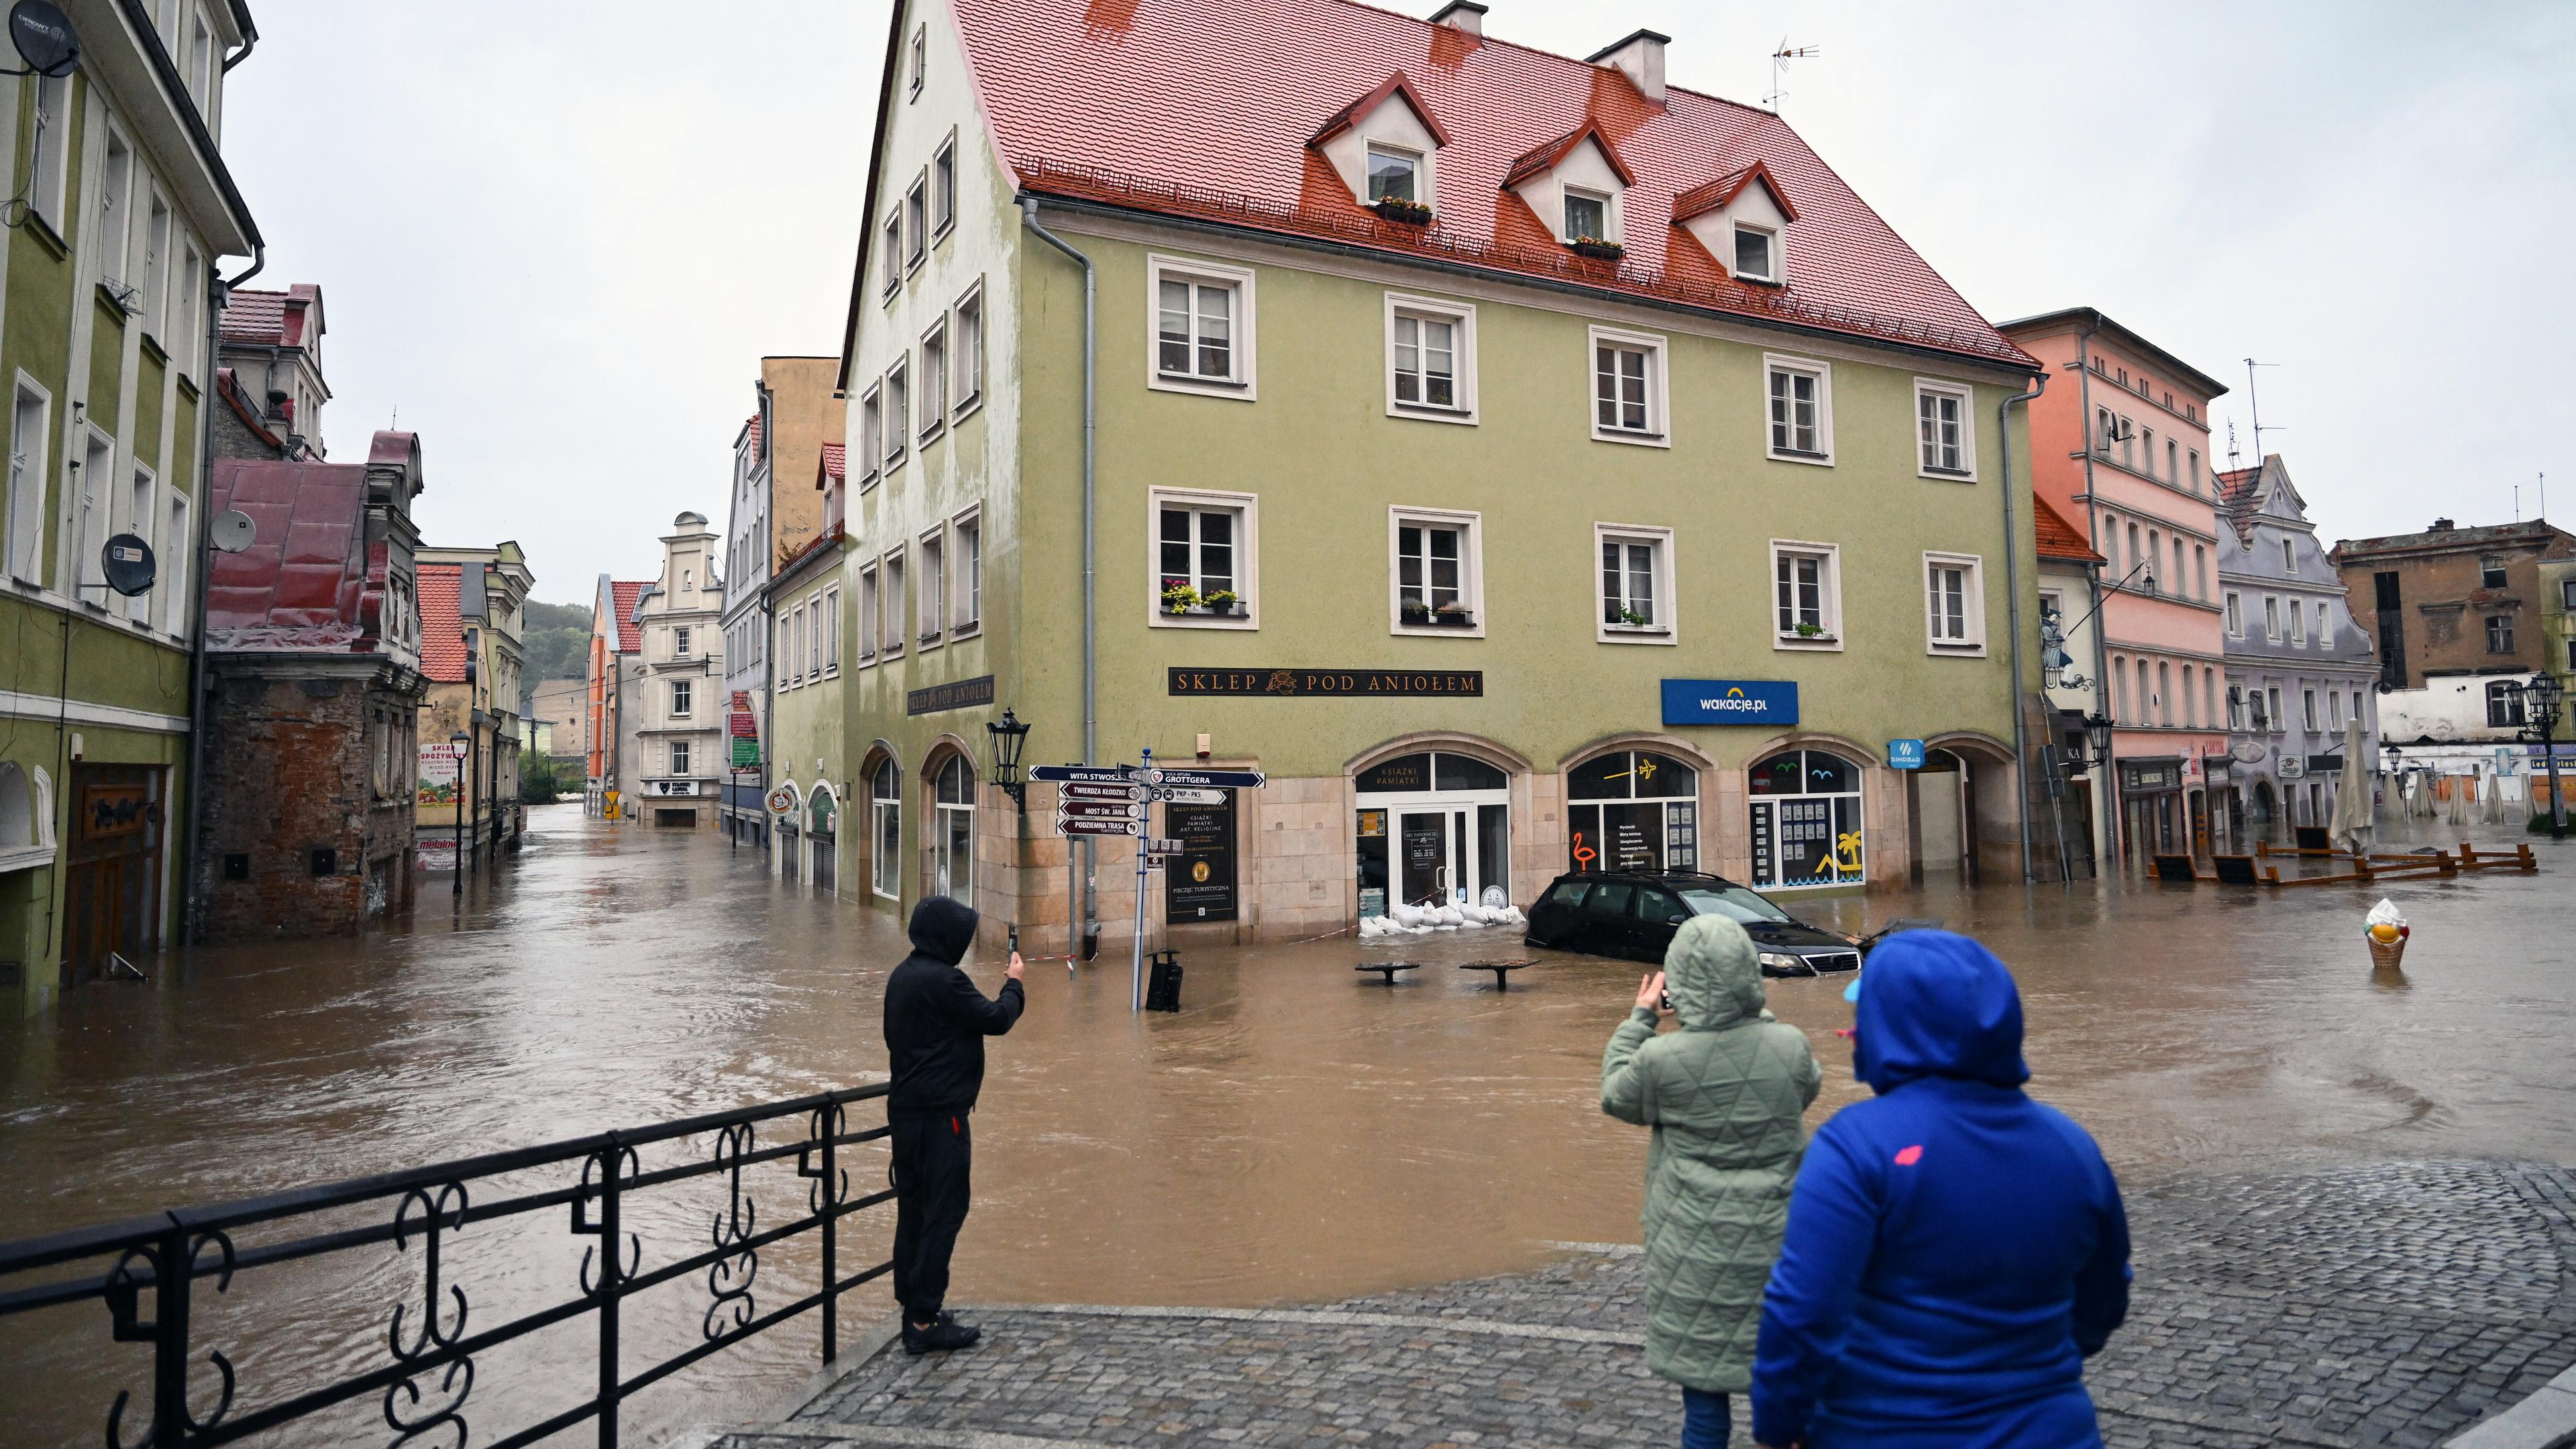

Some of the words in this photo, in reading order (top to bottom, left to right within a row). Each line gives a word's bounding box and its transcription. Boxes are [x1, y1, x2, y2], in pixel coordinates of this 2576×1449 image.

[18, 14, 49, 31] CYFROWY
[1178, 674, 1256, 690] SKLEP
[1306, 675, 1354, 690] POD
[1368, 676, 1476, 692] ANIOŁEM
[909, 694, 927, 710] SKLEP
[938, 689, 953, 704] POD
[1701, 698, 1767, 713] wakacje.pl
[1382, 766, 1416, 776] KSIĄŻKI
[1165, 776, 1210, 784] GROTTGERA
[1377, 777, 1418, 786] PAMIĄTKI
[1074, 787, 1101, 795] TWIERDZA
[1102, 788, 1126, 796] KŁODZKO
[1101, 807, 1111, 815] ŚW.
[420, 840, 462, 849] metalow
